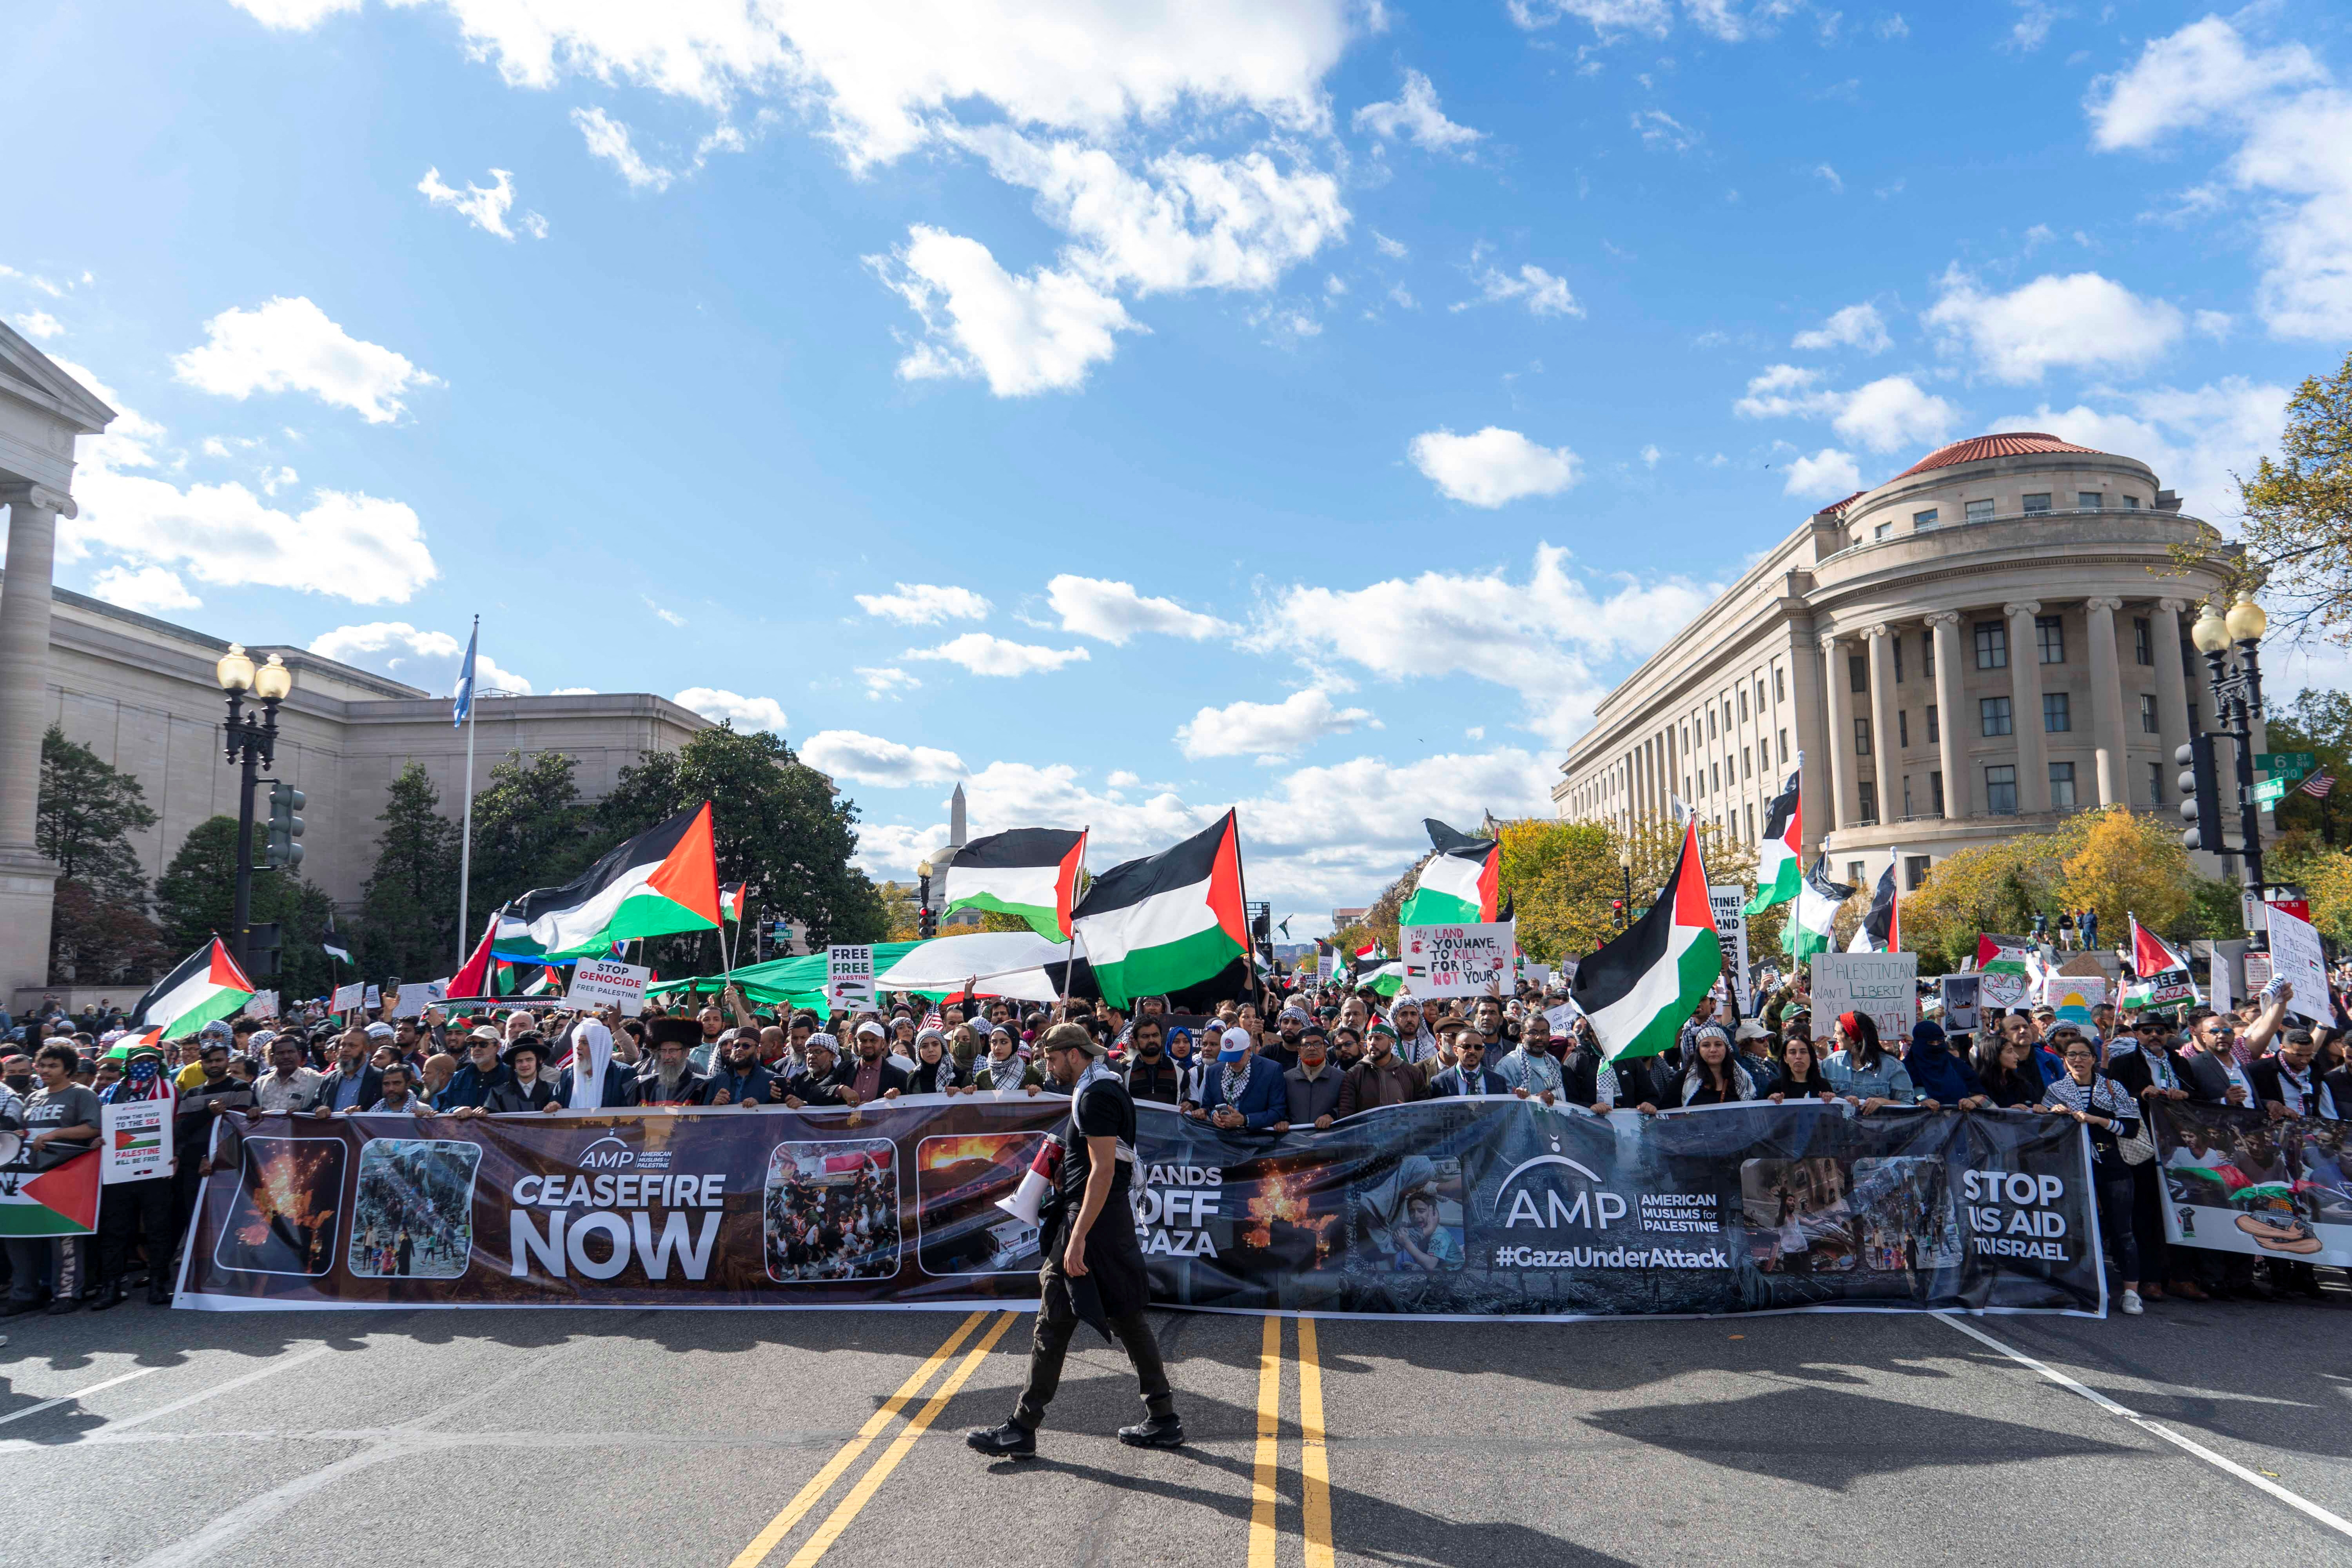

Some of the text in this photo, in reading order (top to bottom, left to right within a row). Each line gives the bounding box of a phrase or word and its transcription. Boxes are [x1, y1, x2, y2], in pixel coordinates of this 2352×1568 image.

[2274, 755, 2287, 768] 6
[2274, 769, 2298, 778] 200
[1716, 919, 1739, 929] AND
[2267, 907, 2289, 931] THE
[1435, 928, 1463, 939] LAND
[832, 949, 868, 960] FREE
[1430, 949, 1481, 960] TO KILL
[597, 964, 629, 975] STOP
[833, 963, 869, 974] FREE
[1431, 960, 1473, 972] FOR IS
[1822, 955, 1916, 980] PALESTINIANS
[2274, 958, 2308, 976] STARTED
[579, 971, 641, 988] GENOCIDE
[1433, 969, 1501, 986] NOT YOURS
[2149, 973, 2178, 987] REE
[598, 987, 638, 999] PALESTINE
[1812, 981, 1905, 999] WANT LIBERTY
[2152, 986, 2194, 1003] GAZA
[1824, 1000, 1907, 1014] YET YOU GIVE
[1552, 1024, 1563, 1033] END
[1564, 1019, 1573, 1028] TH
[28, 1104, 65, 1121] REE
[115, 1147, 160, 1158] PALESTINE
[579, 1152, 634, 1167] AMP
[1145, 1165, 1222, 1186] ANDS
[512, 1174, 727, 1207] CEASEFIRE
[1963, 1169, 2063, 1206] STOP
[1641, 1194, 1717, 1206] AMERICAN
[1505, 1189, 1627, 1229] AMP
[1642, 1208, 1717, 1220] MUSLIMS for
[1643, 1220, 1719, 1232] PALESTINE
[1968, 1206, 2066, 1238] US AID
[510, 1210, 723, 1280] NOW
[1974, 1237, 2069, 1261] TO ISRAEL
[1496, 1246, 1729, 1268] #GazaUnderAttack
